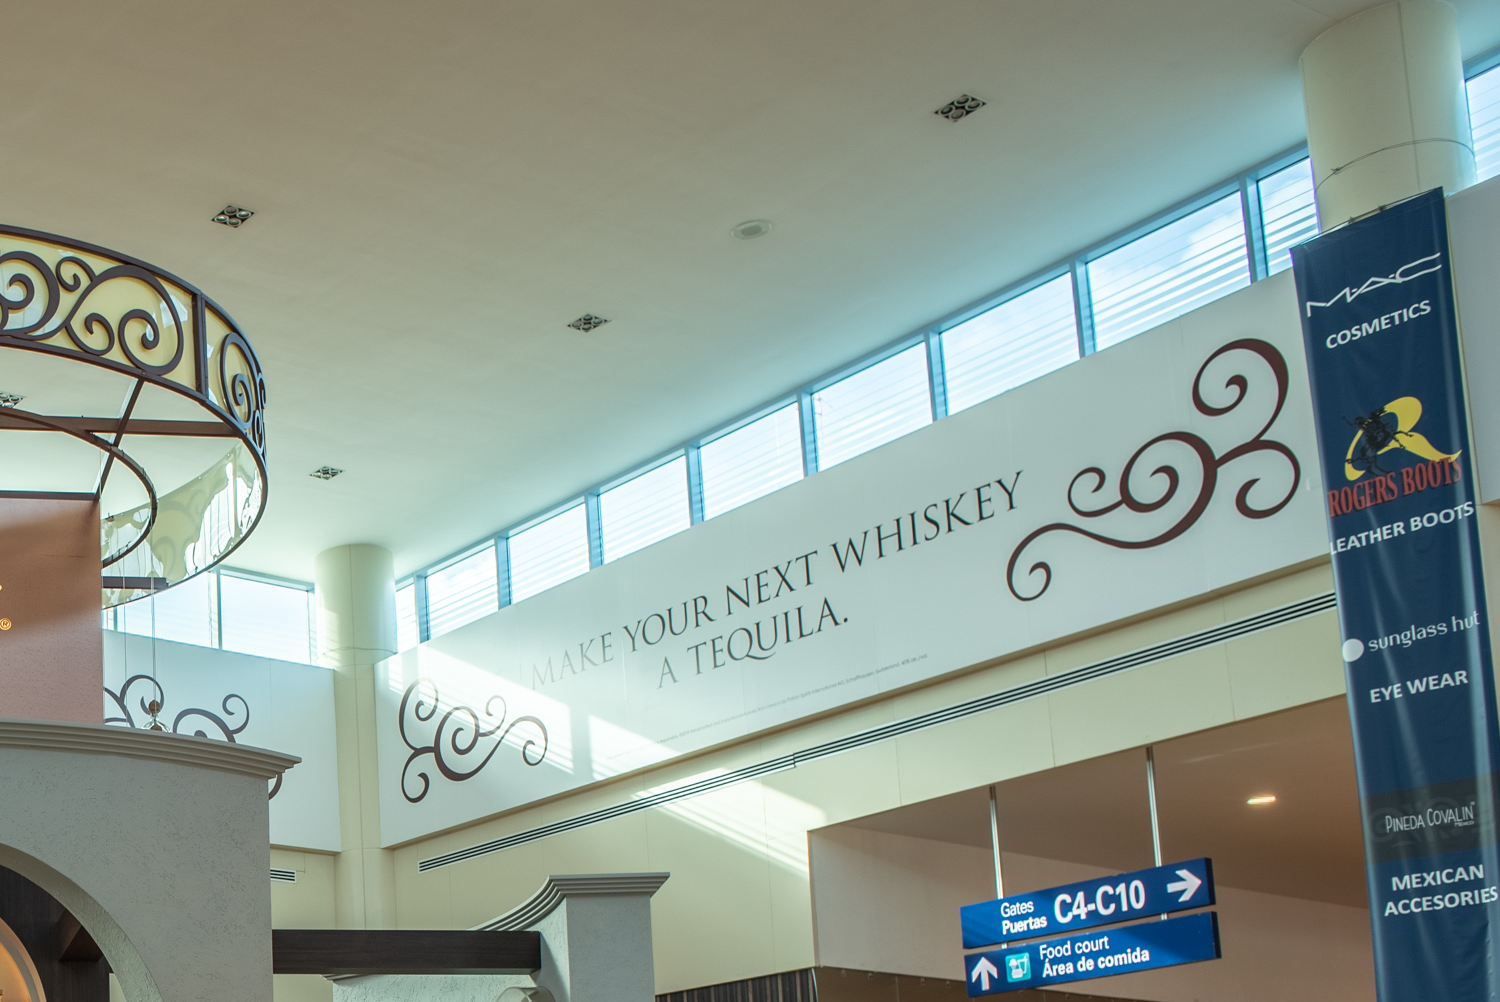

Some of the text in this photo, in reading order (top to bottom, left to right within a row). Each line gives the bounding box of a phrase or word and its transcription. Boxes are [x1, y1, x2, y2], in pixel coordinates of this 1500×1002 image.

[1325, 300, 1431, 349] COSMETICS
[1328, 456, 1462, 518] ROGERS BOOTS
[1330, 501, 1474, 556] LEATHER BOOTS
[531, 470, 1024, 691] MAKE YOUR NEXT WHISKEY
[656, 596, 850, 690] A TEQUILA.
[1368, 610, 1480, 652] sunglass hut
[1370, 670, 1469, 703] EYE WEAR
[1391, 864, 1484, 891] MEXICAN
[1000, 900, 1034, 918] Gates
[1053, 879, 1146, 924] C4-C10
[1384, 886, 1498, 917] ACCESORIES
[1001, 916, 1048, 935] Puertas
[1039, 935, 1109, 960] Food court
[1042, 947, 1150, 978] Área de comida
